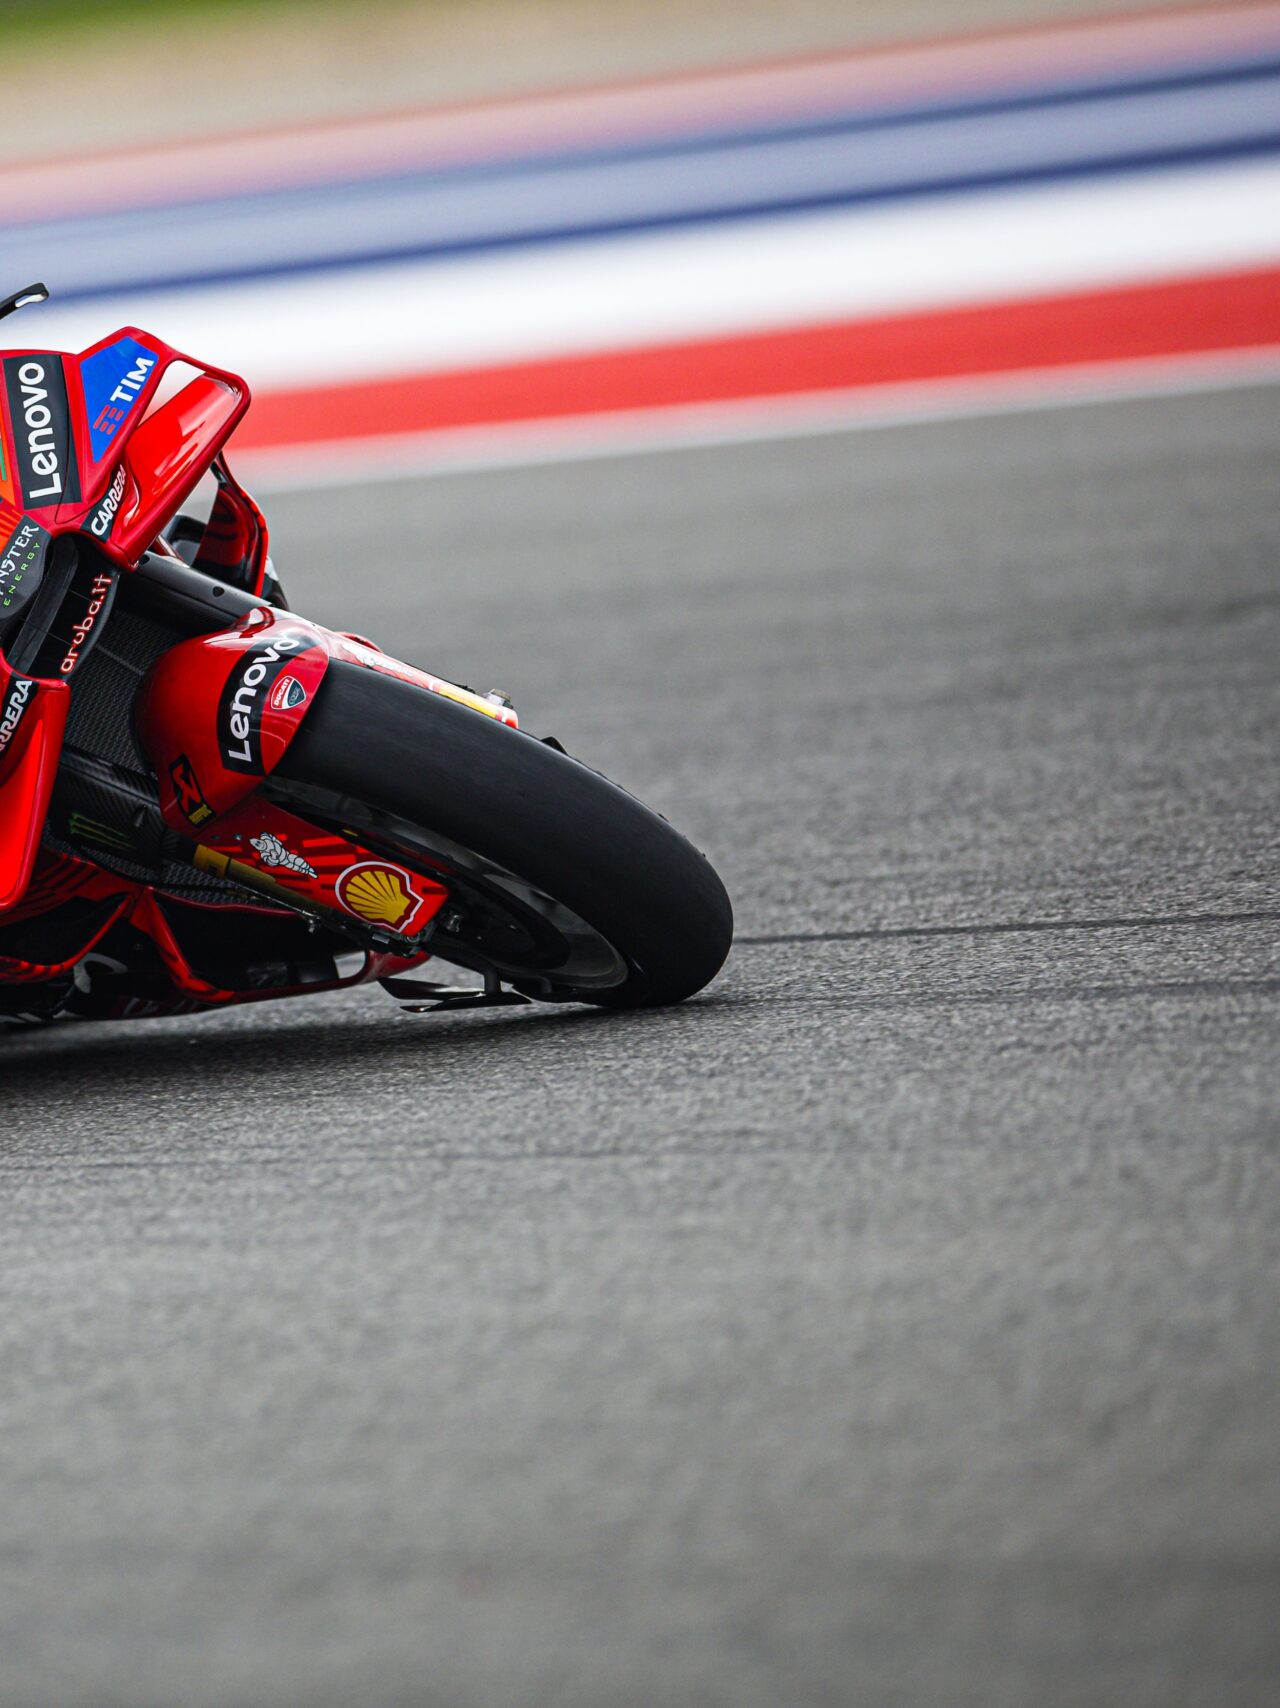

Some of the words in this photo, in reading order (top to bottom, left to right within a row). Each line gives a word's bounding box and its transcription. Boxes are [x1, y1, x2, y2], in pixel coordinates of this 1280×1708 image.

[110, 357, 155, 403] TIM
[18, 362, 63, 499] Lenovo
[3, 540, 40, 607] ENERGY
[61, 575, 112, 674] aruba.it
[228, 639, 300, 763] Lenovo
[274, 679, 290, 706] DUCATI
